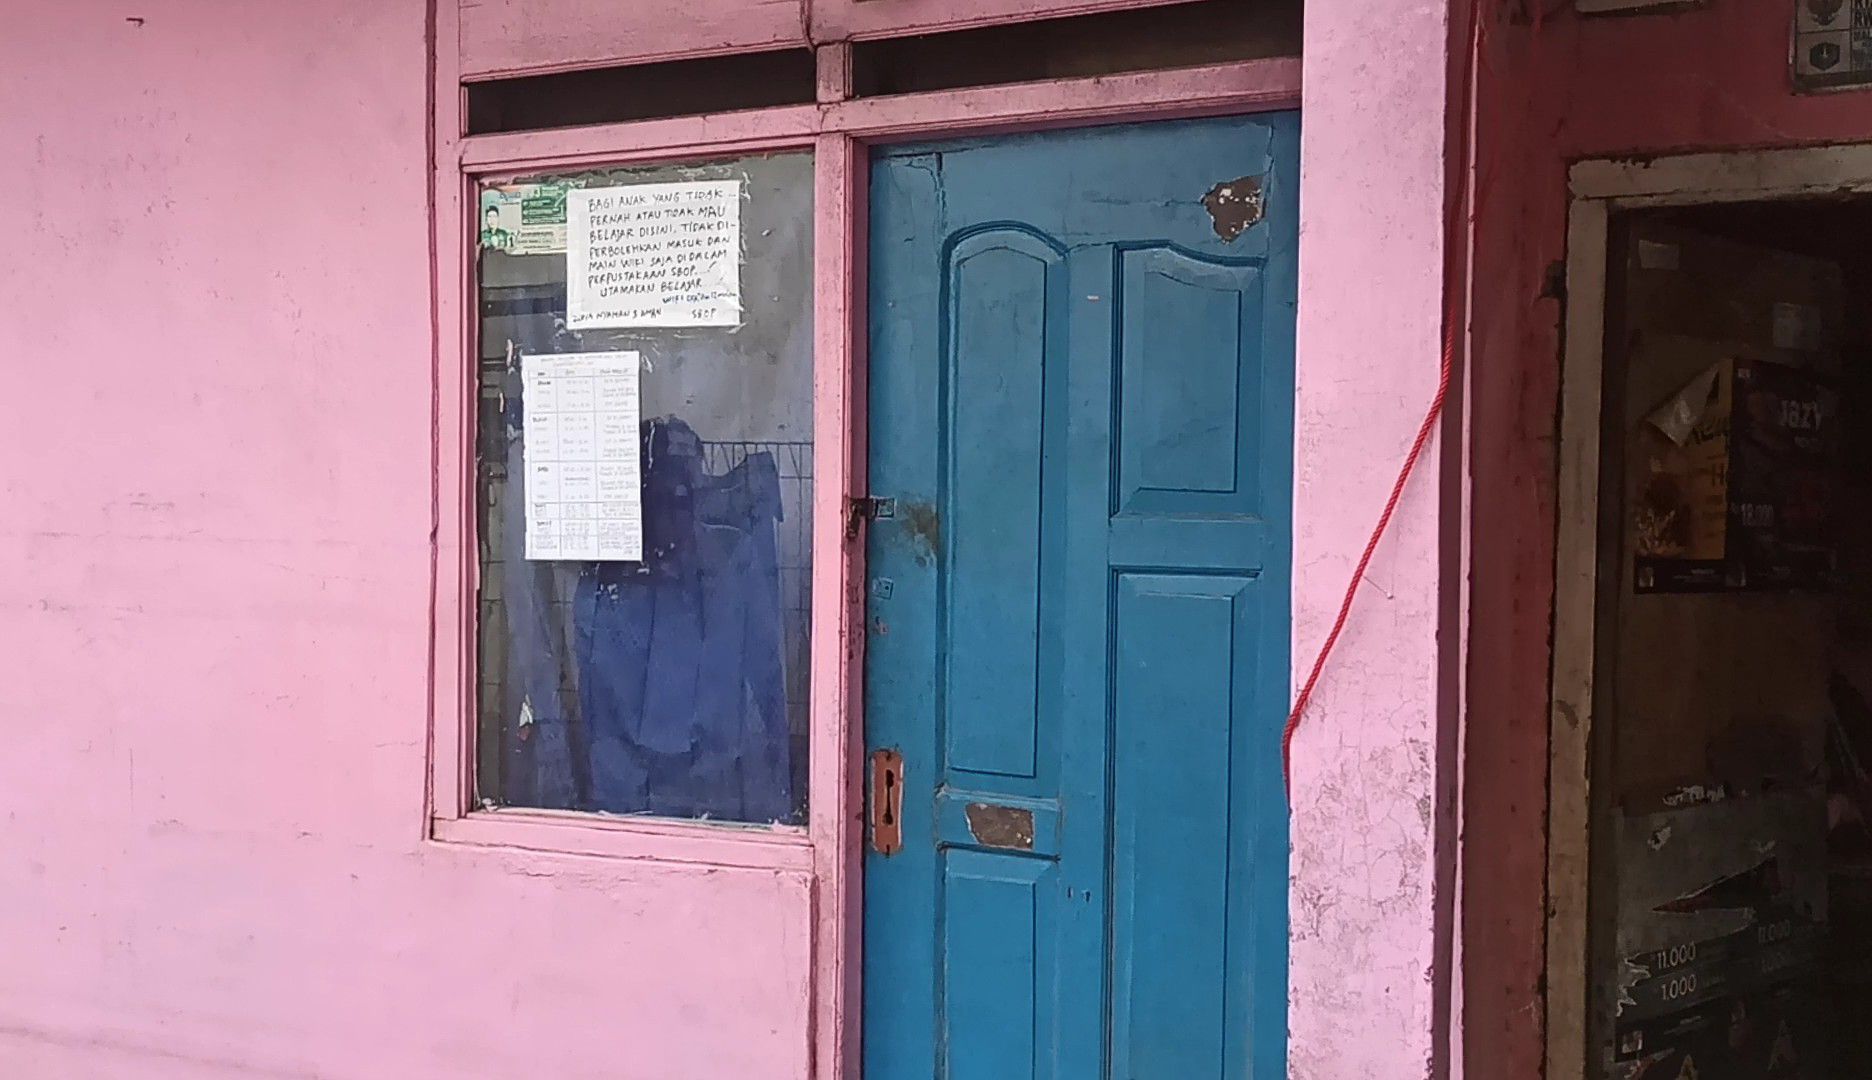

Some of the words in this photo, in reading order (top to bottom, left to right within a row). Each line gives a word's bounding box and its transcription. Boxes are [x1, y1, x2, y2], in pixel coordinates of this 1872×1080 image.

[589, 198, 614, 213] BAGI
[619, 194, 647, 207] ANAK
[652, 191, 680, 206] YANG
[686, 188, 723, 201] TIDAK
[590, 213, 631, 228] PERNAH
[636, 209, 661, 221] ATAU
[698, 204, 726, 219] MAU
[590, 228, 635, 244] BELAJAR
[681, 221, 714, 233] TIDAK
[590, 241, 661, 260] PERBOLEHKAN
[667, 238, 703, 249] MASUK
[707, 235, 731, 246] DAN
[589, 259, 616, 272] MAIN
[650, 255, 673, 267] SAJA
[677, 249, 727, 264] DIDALAM
[588, 269, 666, 288] PERPUSTAKAAN
[600, 282, 655, 298] UTAMAKAN
[661, 277, 702, 292] BELAJAR
[1657, 941, 1696, 969] 11.000
[1662, 974, 1697, 1000] 1.000
